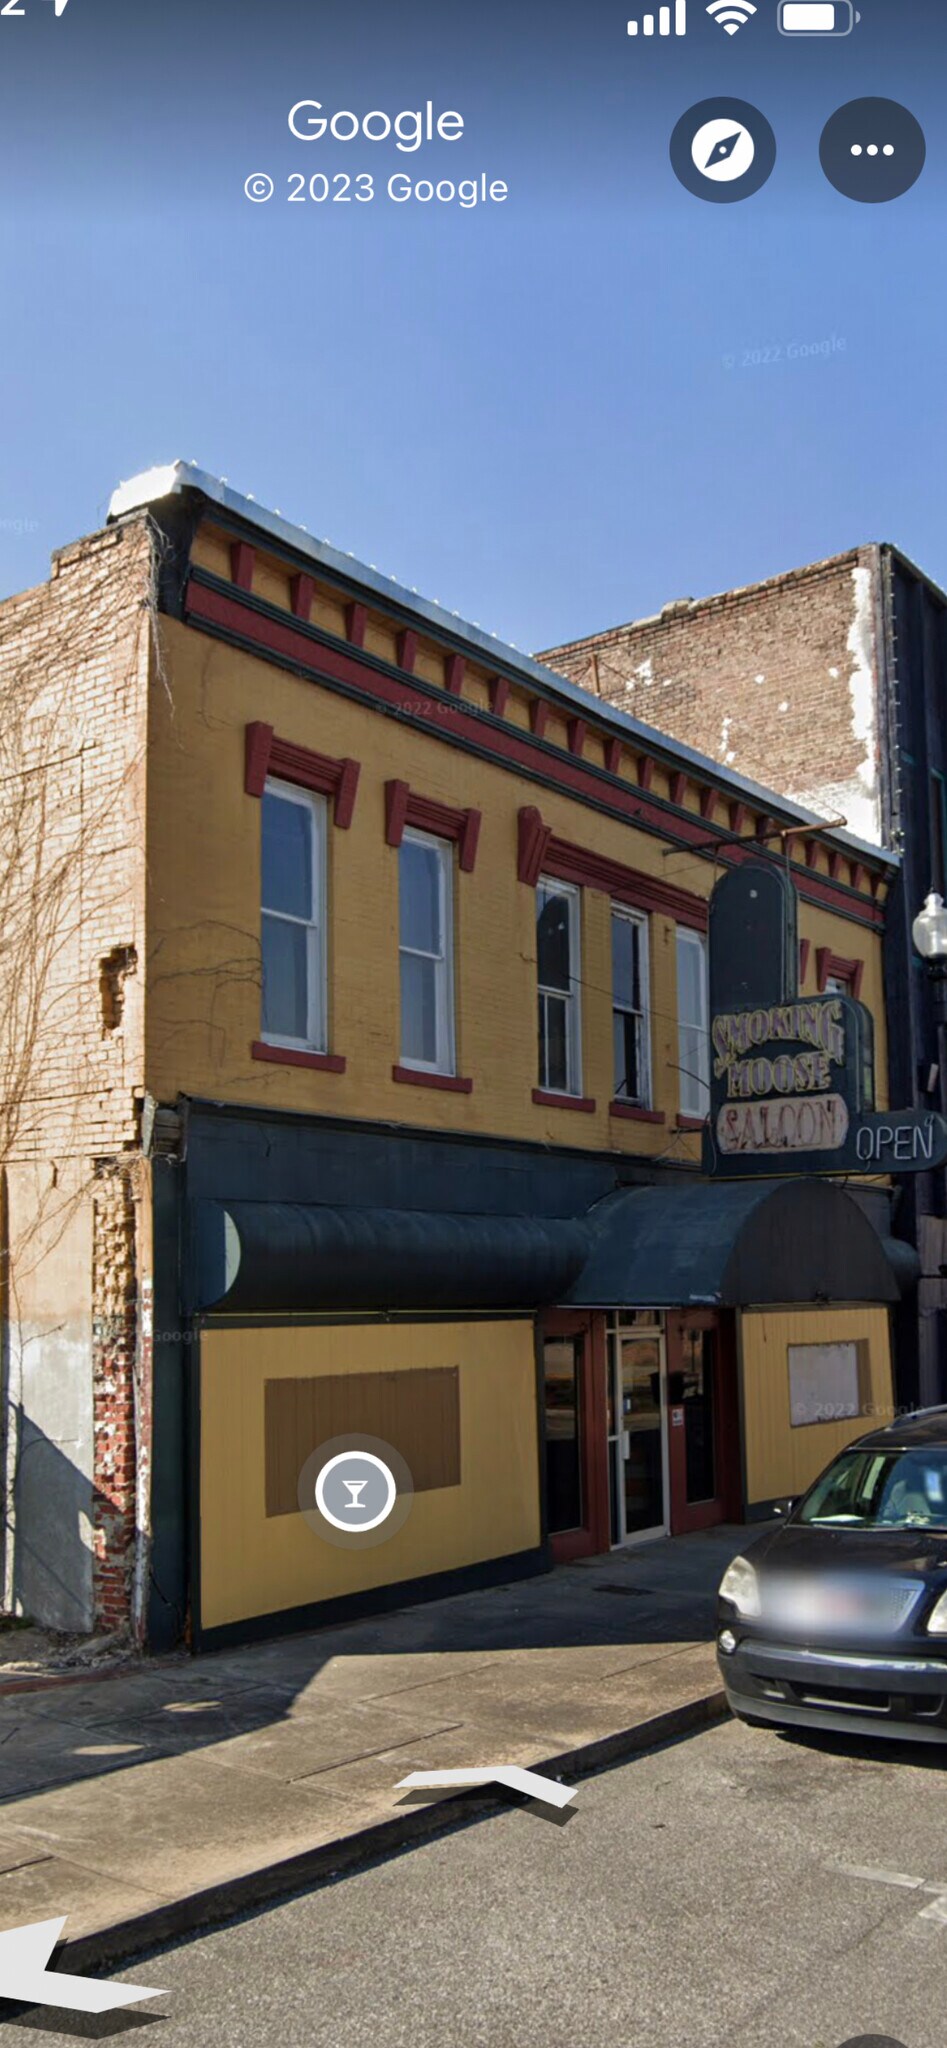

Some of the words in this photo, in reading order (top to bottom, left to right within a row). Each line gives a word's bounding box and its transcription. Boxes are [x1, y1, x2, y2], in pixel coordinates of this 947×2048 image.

[712, 1000, 846, 1079] SMOKING
[727, 1052, 832, 1098] MOOSE
[725, 1099, 838, 1150] SALOON
[856, 1115, 934, 1160] OPEN
